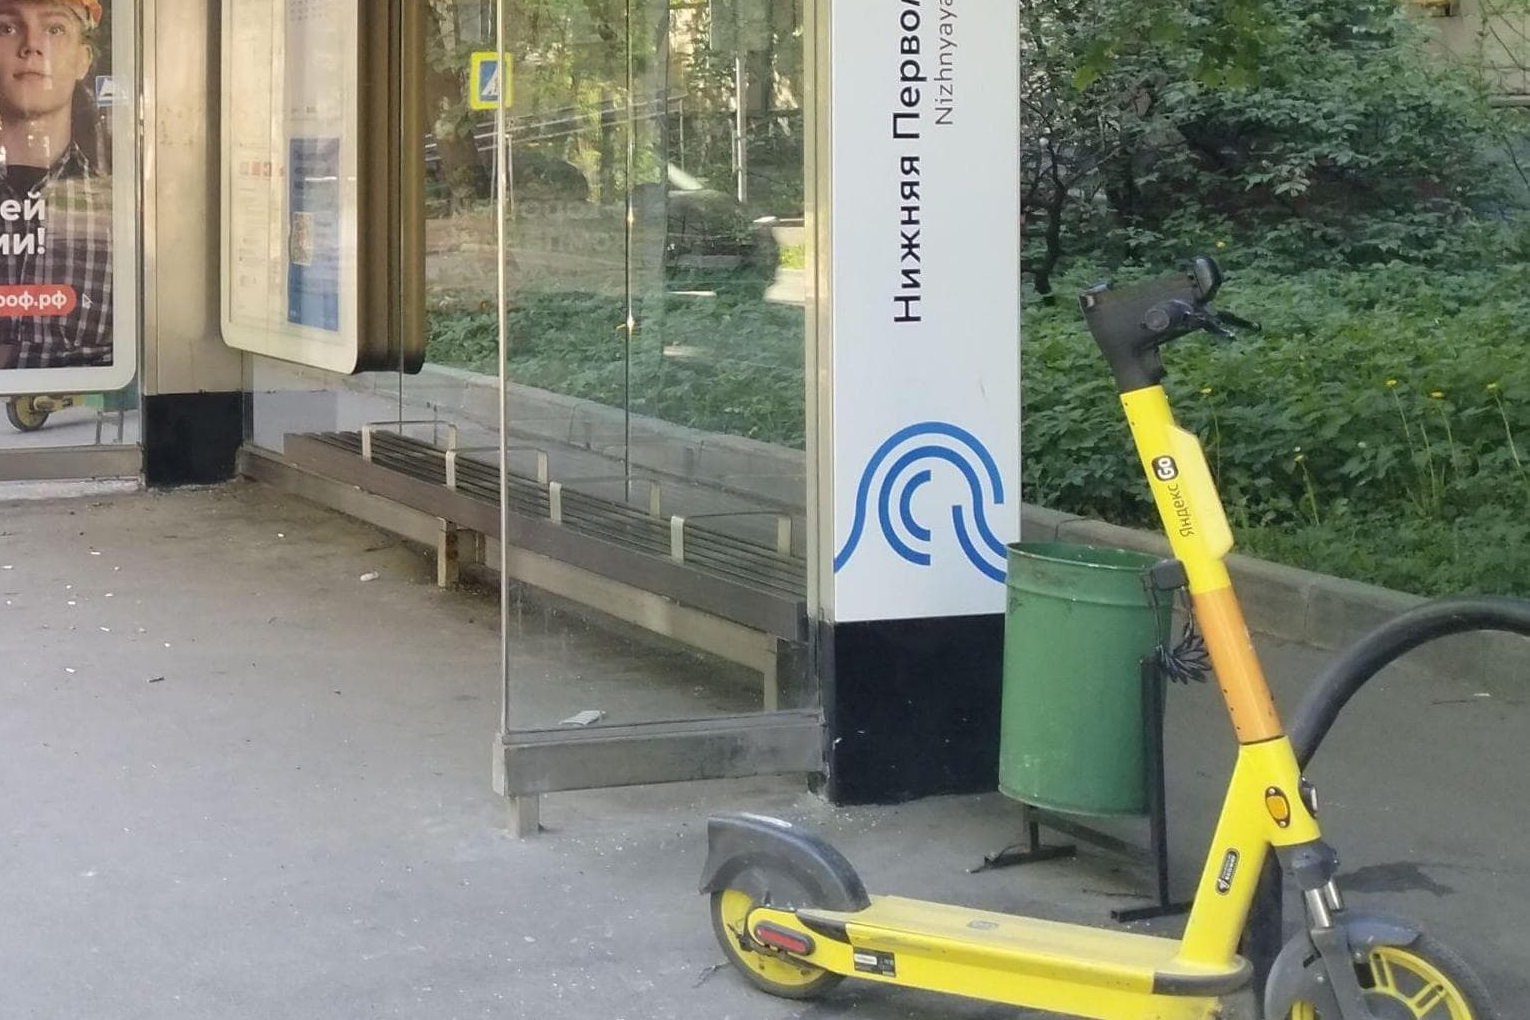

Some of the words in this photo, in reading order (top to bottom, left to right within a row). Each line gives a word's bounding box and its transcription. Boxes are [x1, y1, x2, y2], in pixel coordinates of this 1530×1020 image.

[893, 156, 921, 322] Нижняя
[1157, 457, 1175, 479] Go
[1167, 483, 1195, 537] Яндекс
